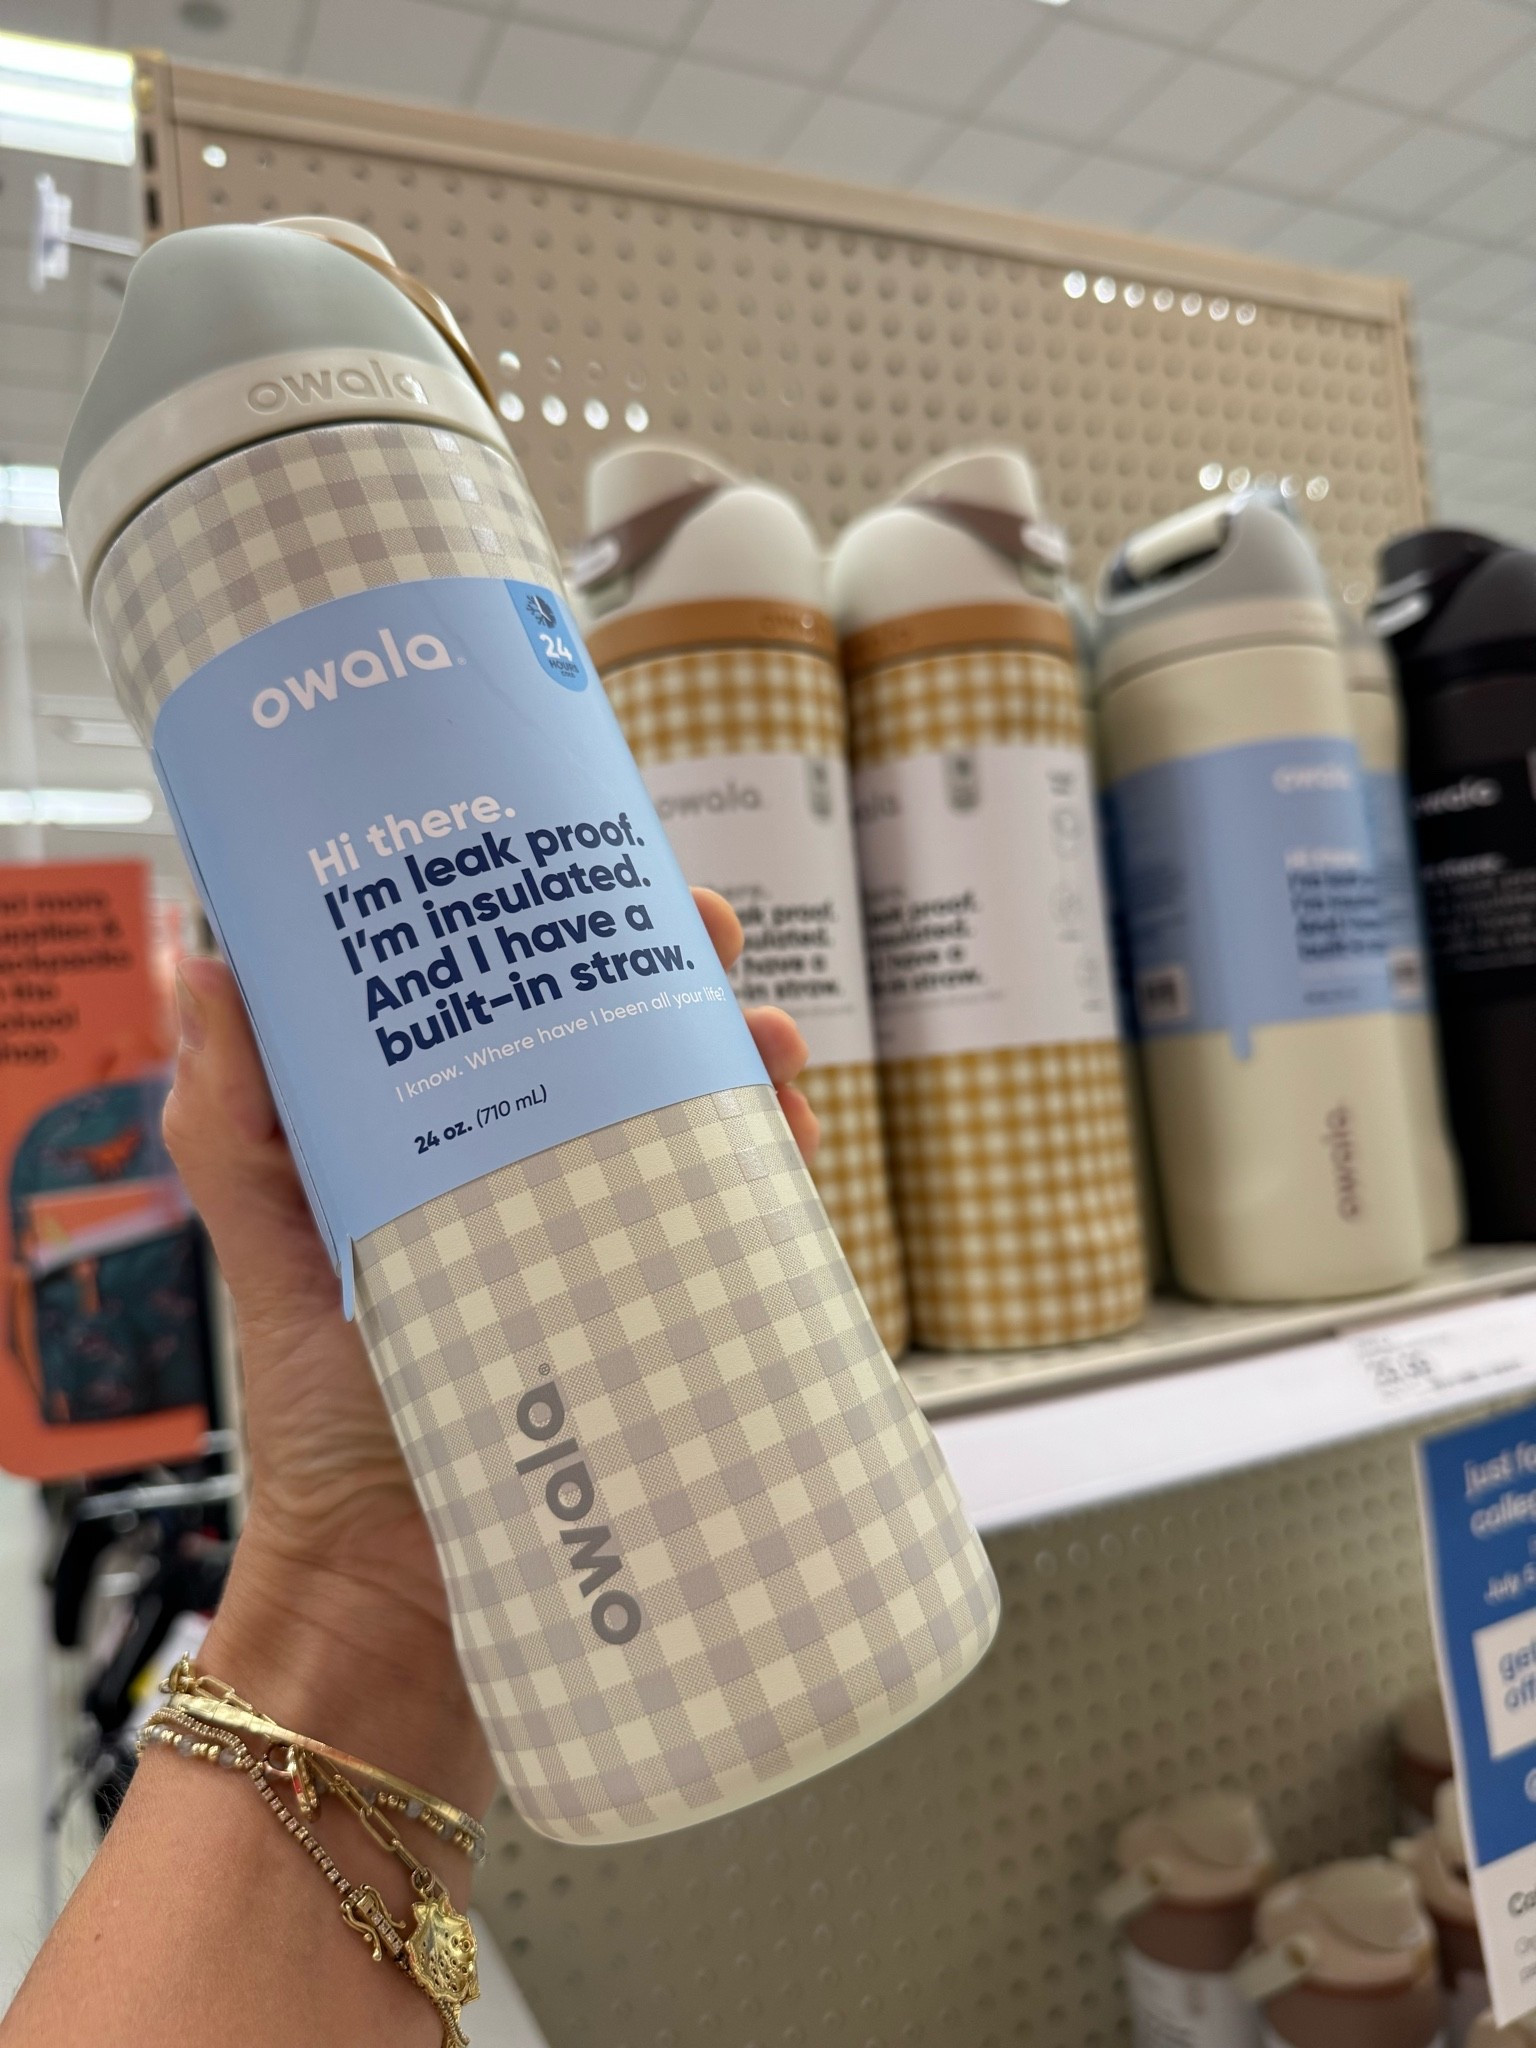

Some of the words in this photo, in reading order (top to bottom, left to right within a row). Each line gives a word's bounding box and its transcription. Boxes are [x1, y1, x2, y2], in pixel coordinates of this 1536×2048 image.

[247, 359, 428, 416] owala
[252, 627, 453, 730] owala
[539, 633, 573, 662] 24
[307, 832, 361, 887] Hi
[366, 795, 516, 857] there.
[324, 877, 403, 931] I'm
[404, 831, 522, 895] leak
[525, 812, 645, 868] proof.
[341, 921, 420, 976] I'm
[422, 853, 652, 939] insulated.
[365, 944, 464, 1022] And
[467, 934, 492, 975] I
[494, 909, 617, 965] have
[624, 904, 655, 932] a
[374, 971, 563, 1067] built-in
[570, 944, 695, 992] straw.
[408, 1062, 464, 1099] know.
[464, 1034, 536, 1072] Where
[536, 1018, 589, 1045] have
[590, 1010, 600, 1027] I
[601, 999, 650, 1024] been
[651, 990, 672, 1010] all
[673, 989, 703, 1010] your
[703, 985, 727, 1002] life?
[413, 1130, 441, 1155] 24
[442, 1120, 474, 1141] oz.
[475, 1098, 512, 1129] (710
[514, 1083, 548, 1112] mL)
[514, 1380, 642, 1646] owala
